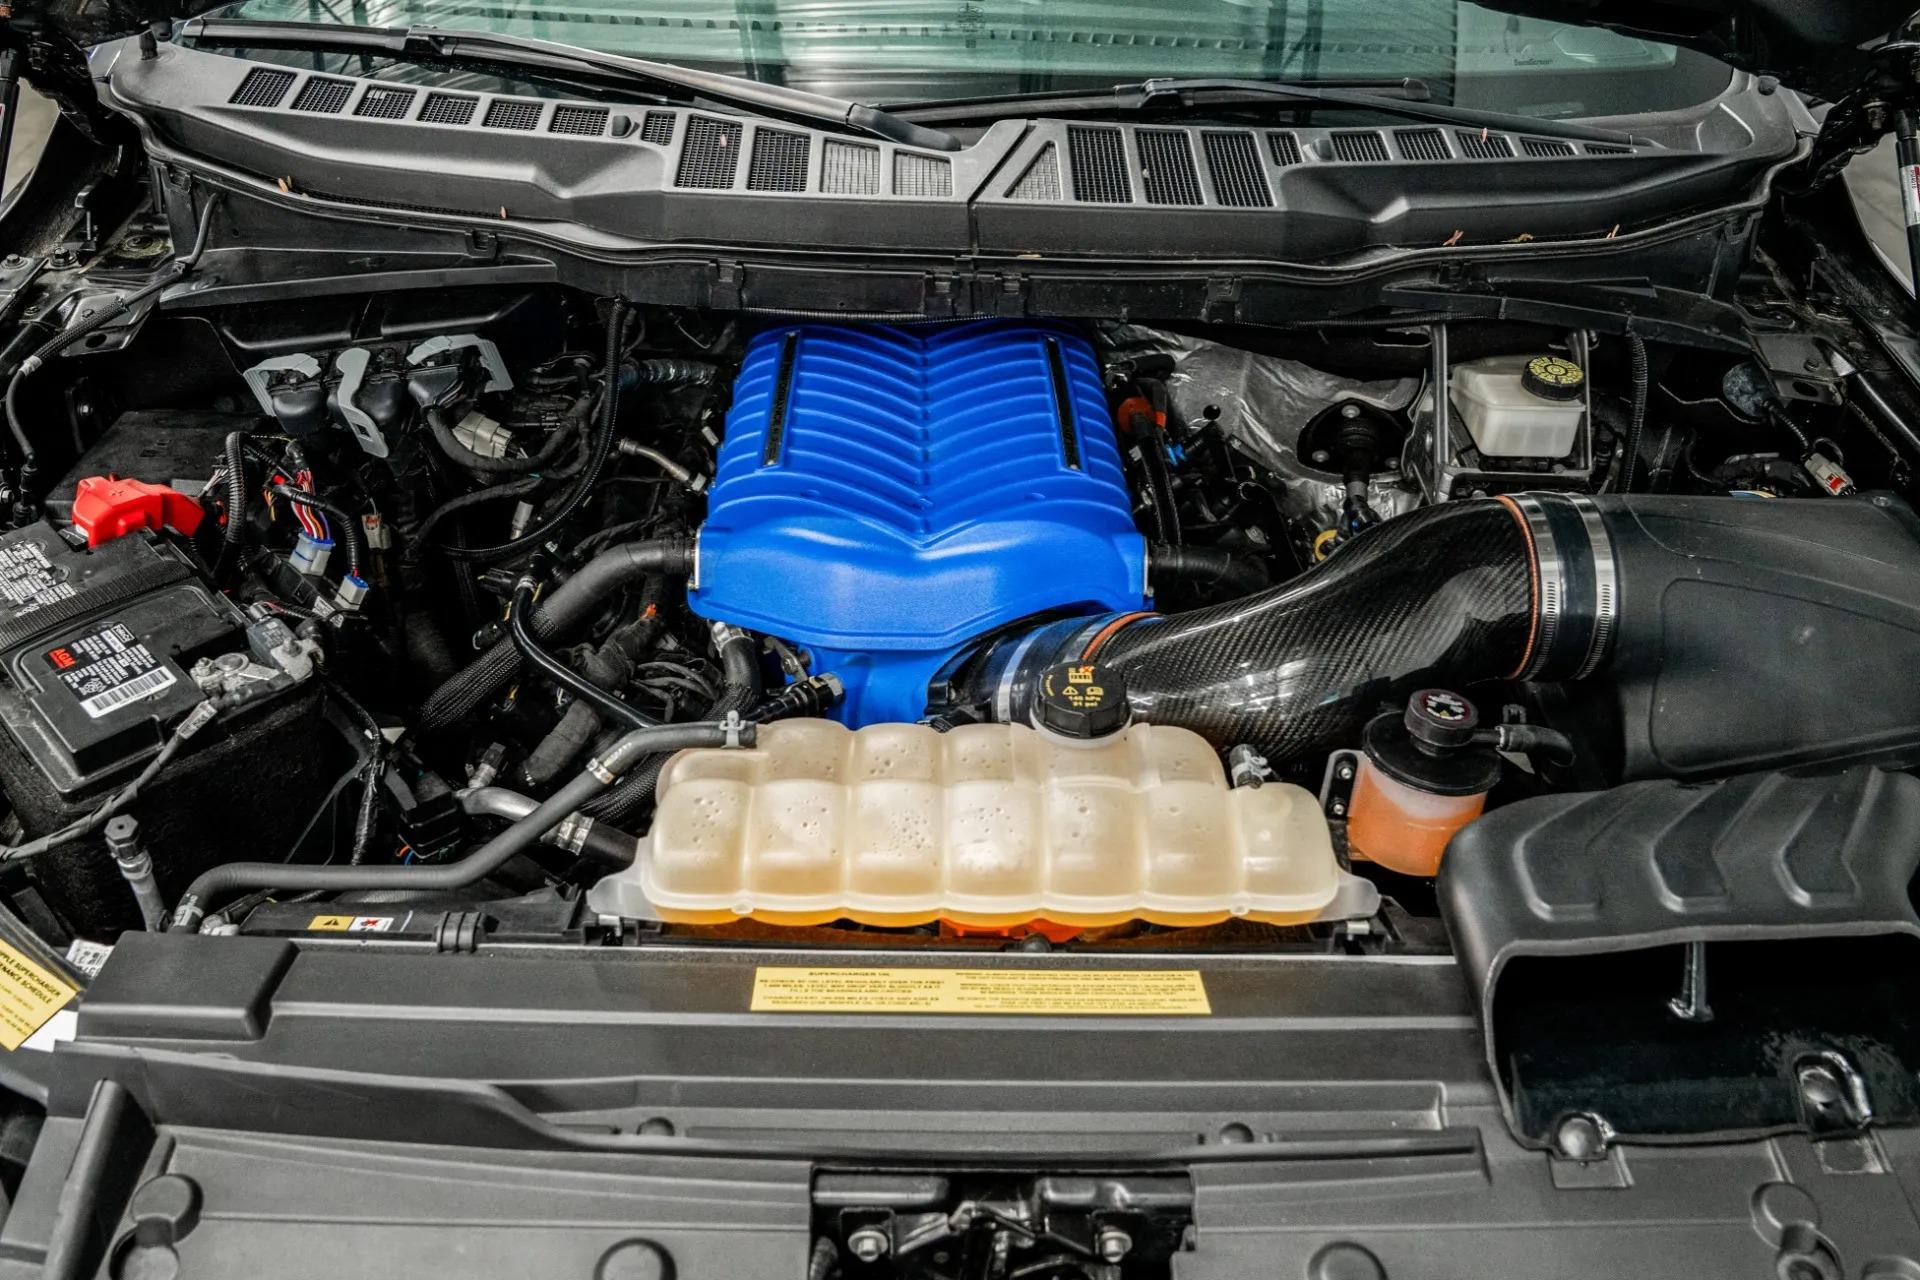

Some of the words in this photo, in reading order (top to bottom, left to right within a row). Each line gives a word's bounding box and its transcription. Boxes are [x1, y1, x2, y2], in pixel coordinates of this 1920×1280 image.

[54, 647, 76, 666] AGM
[14, 963, 61, 997] SUPERCHARGER
[20, 979, 53, 1004] SCHEDULE
